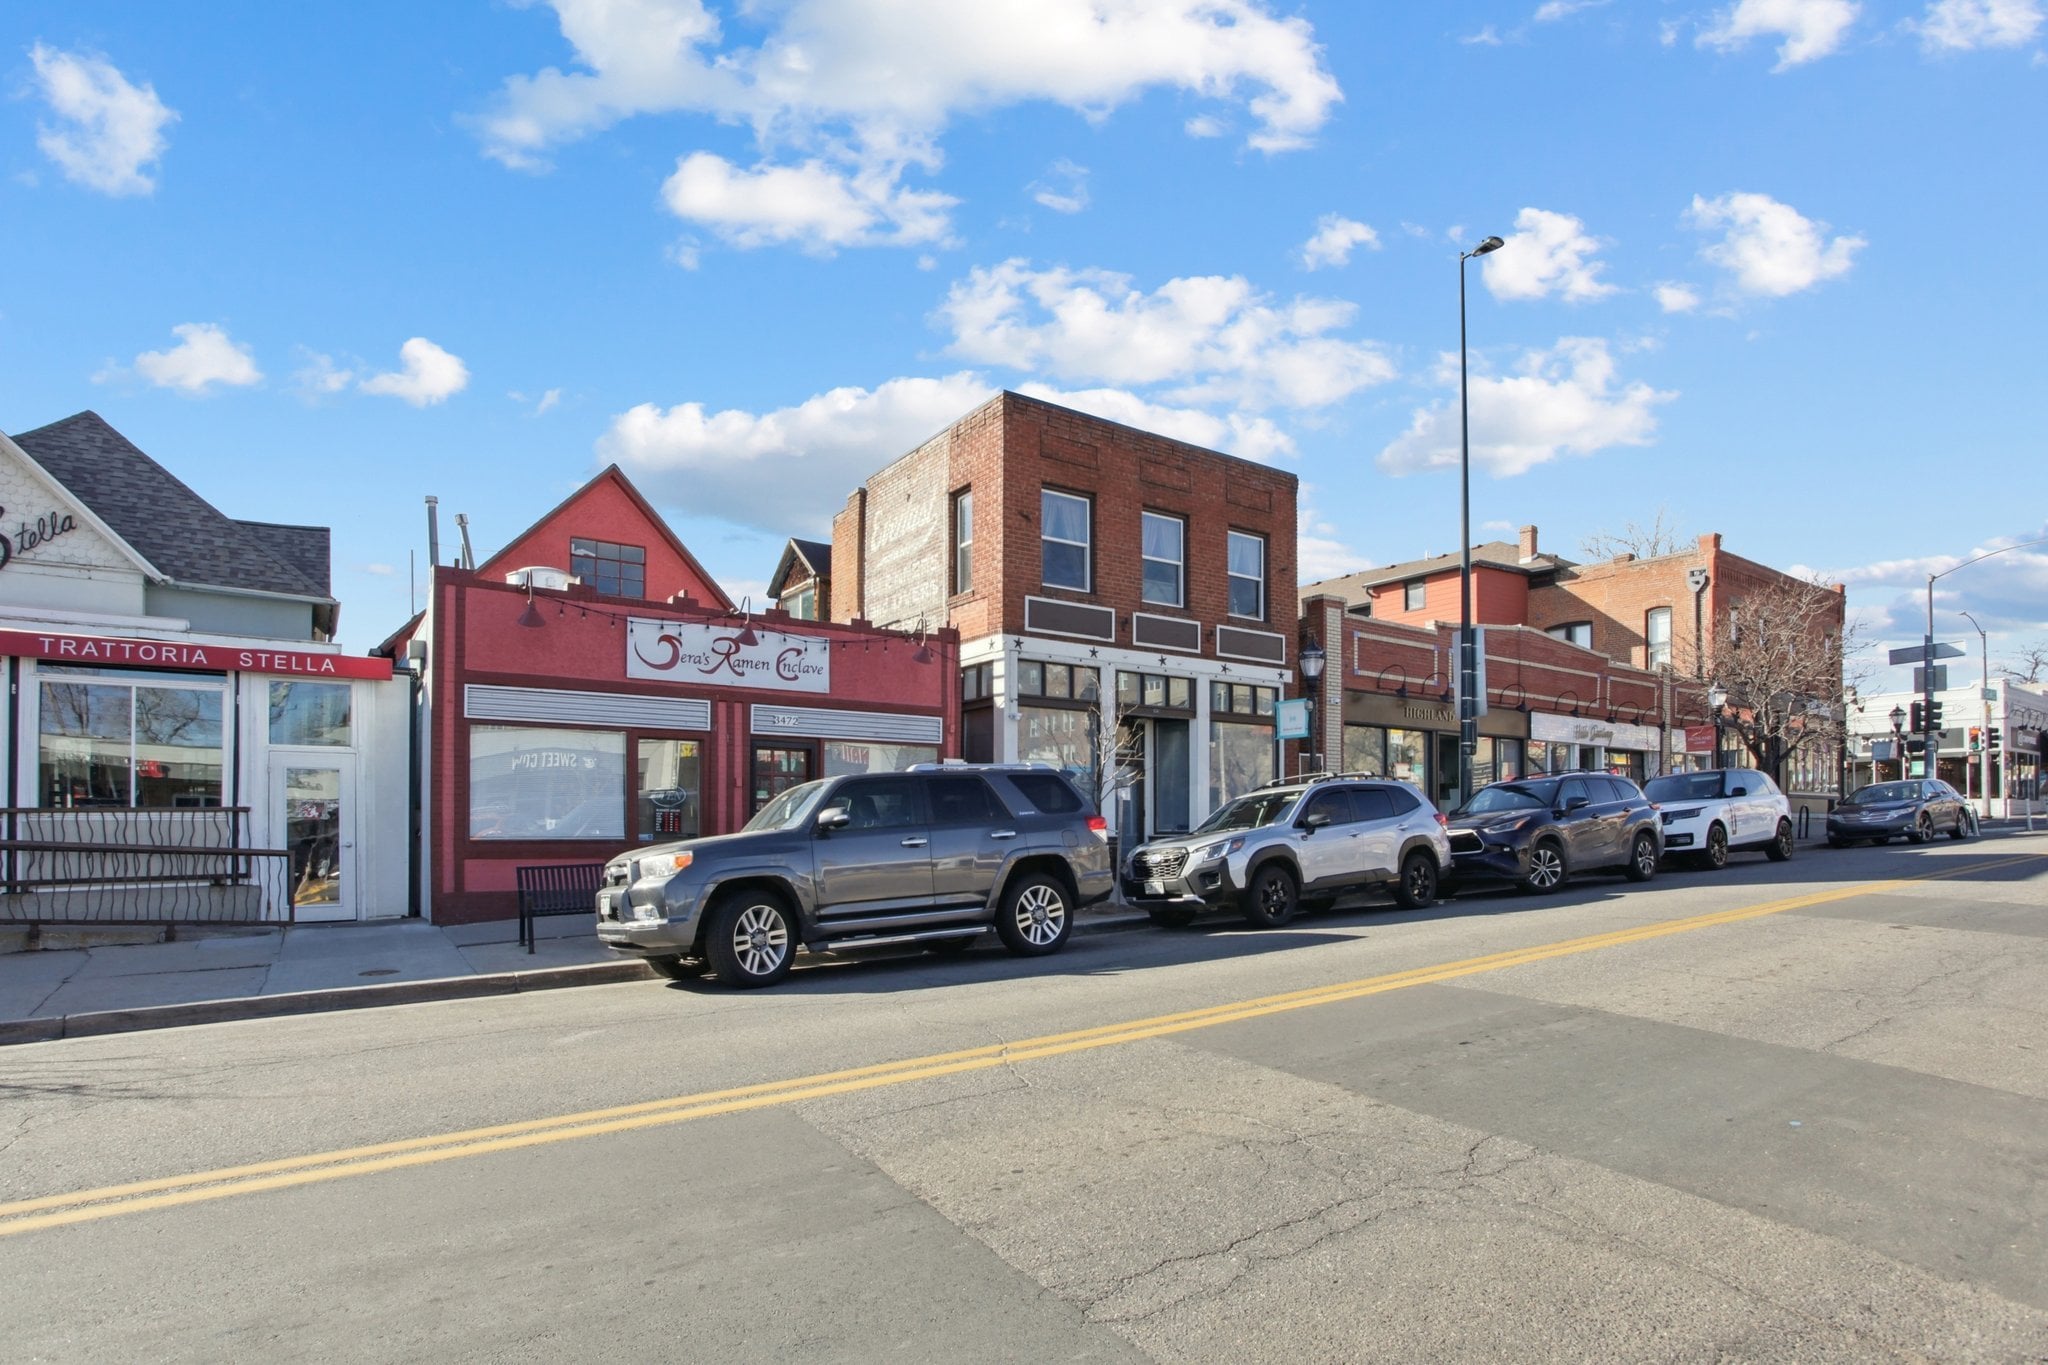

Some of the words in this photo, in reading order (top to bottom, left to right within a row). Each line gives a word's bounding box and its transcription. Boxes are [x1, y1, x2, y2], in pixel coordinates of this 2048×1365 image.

[39, 637, 208, 665] TRATTORIA
[239, 652, 335, 673] STELLA
[634, 634, 710, 671] Sera's
[697, 636, 770, 677] Ramen
[776, 647, 824, 681] Enclave
[773, 714, 799, 726] 3472
